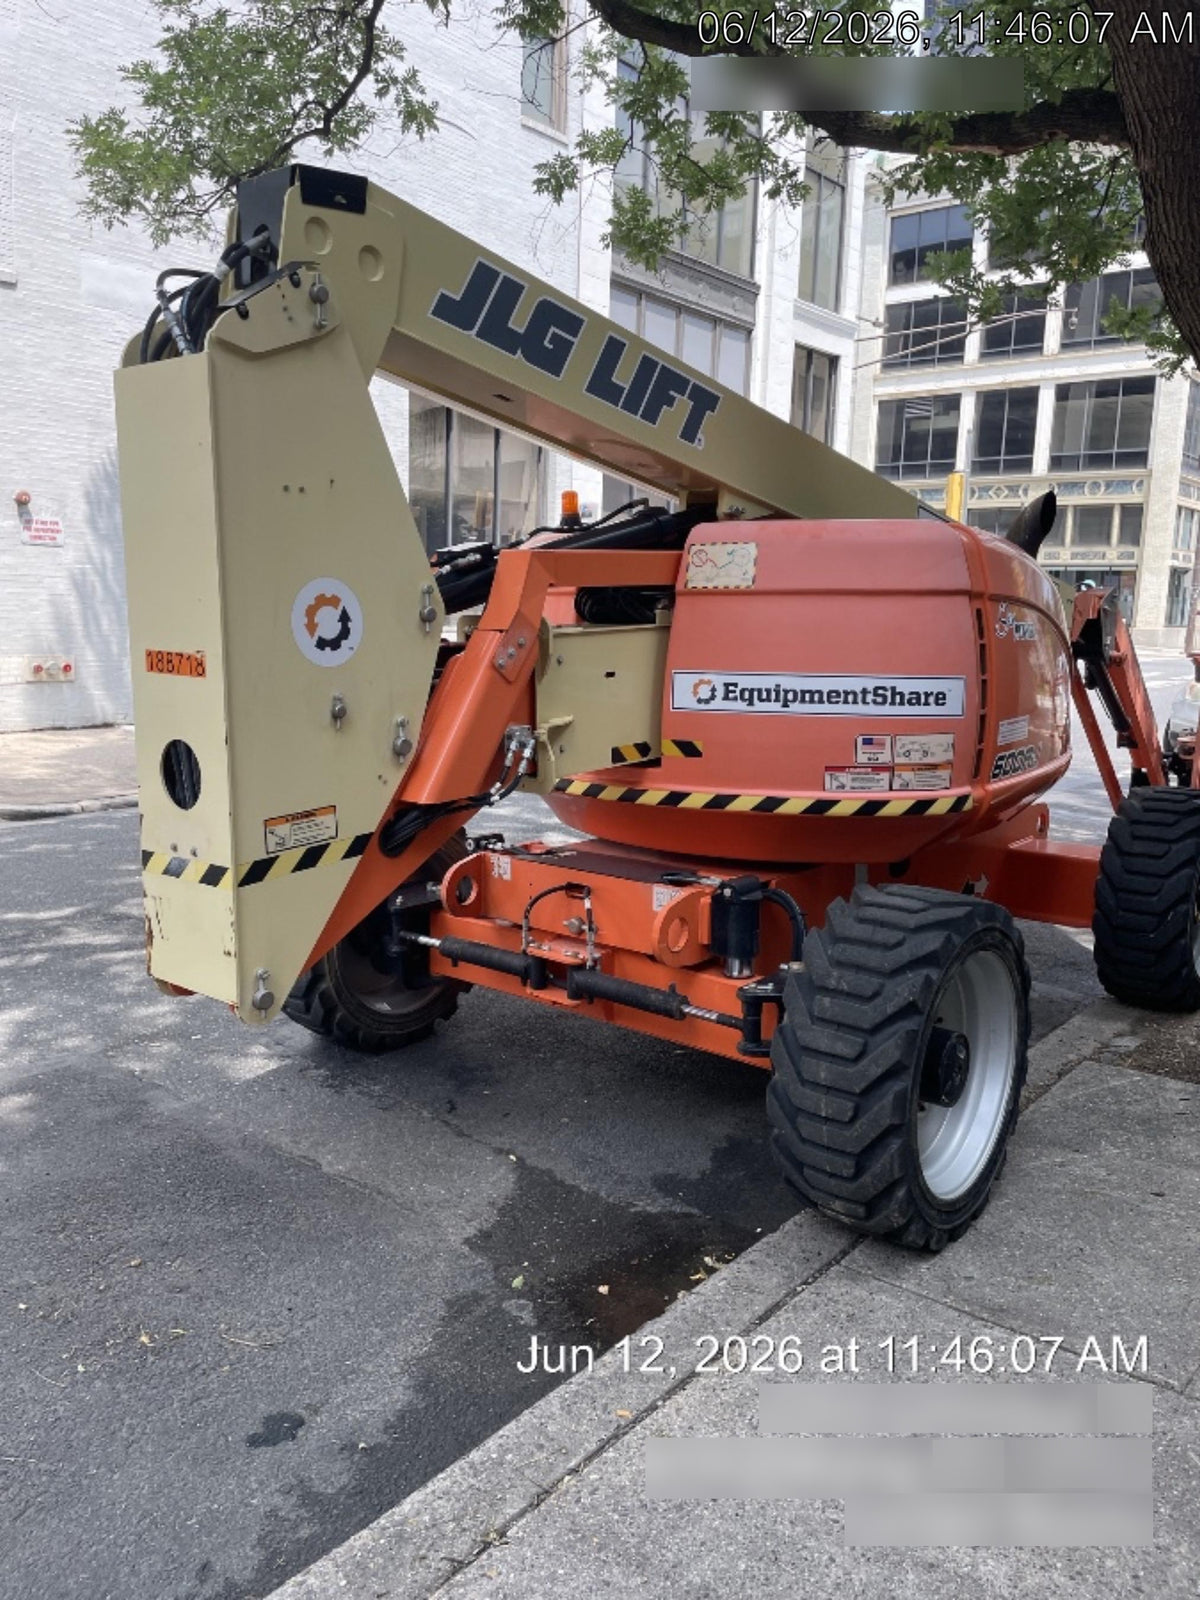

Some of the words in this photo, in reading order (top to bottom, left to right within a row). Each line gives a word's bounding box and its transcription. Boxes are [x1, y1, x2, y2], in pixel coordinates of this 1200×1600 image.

[428, 256, 587, 381] JLG
[583, 332, 722, 446] LIFT
[722, 681, 947, 708] EquipmentShare
